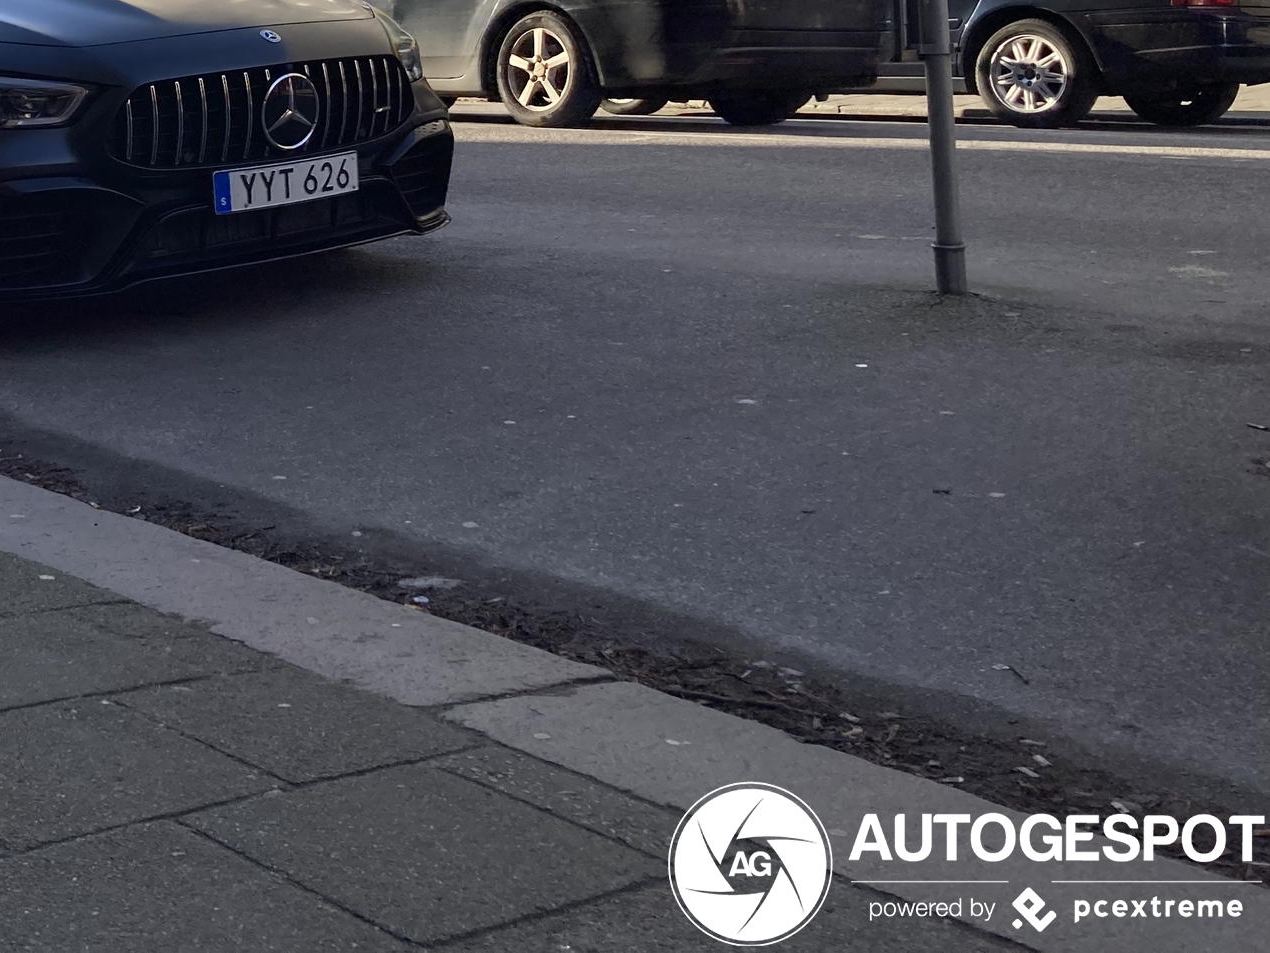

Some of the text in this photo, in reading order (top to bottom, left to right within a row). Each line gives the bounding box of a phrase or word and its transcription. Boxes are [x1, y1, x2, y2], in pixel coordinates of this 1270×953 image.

[240, 158, 350, 205] YYT 626
[220, 197, 227, 206] S
